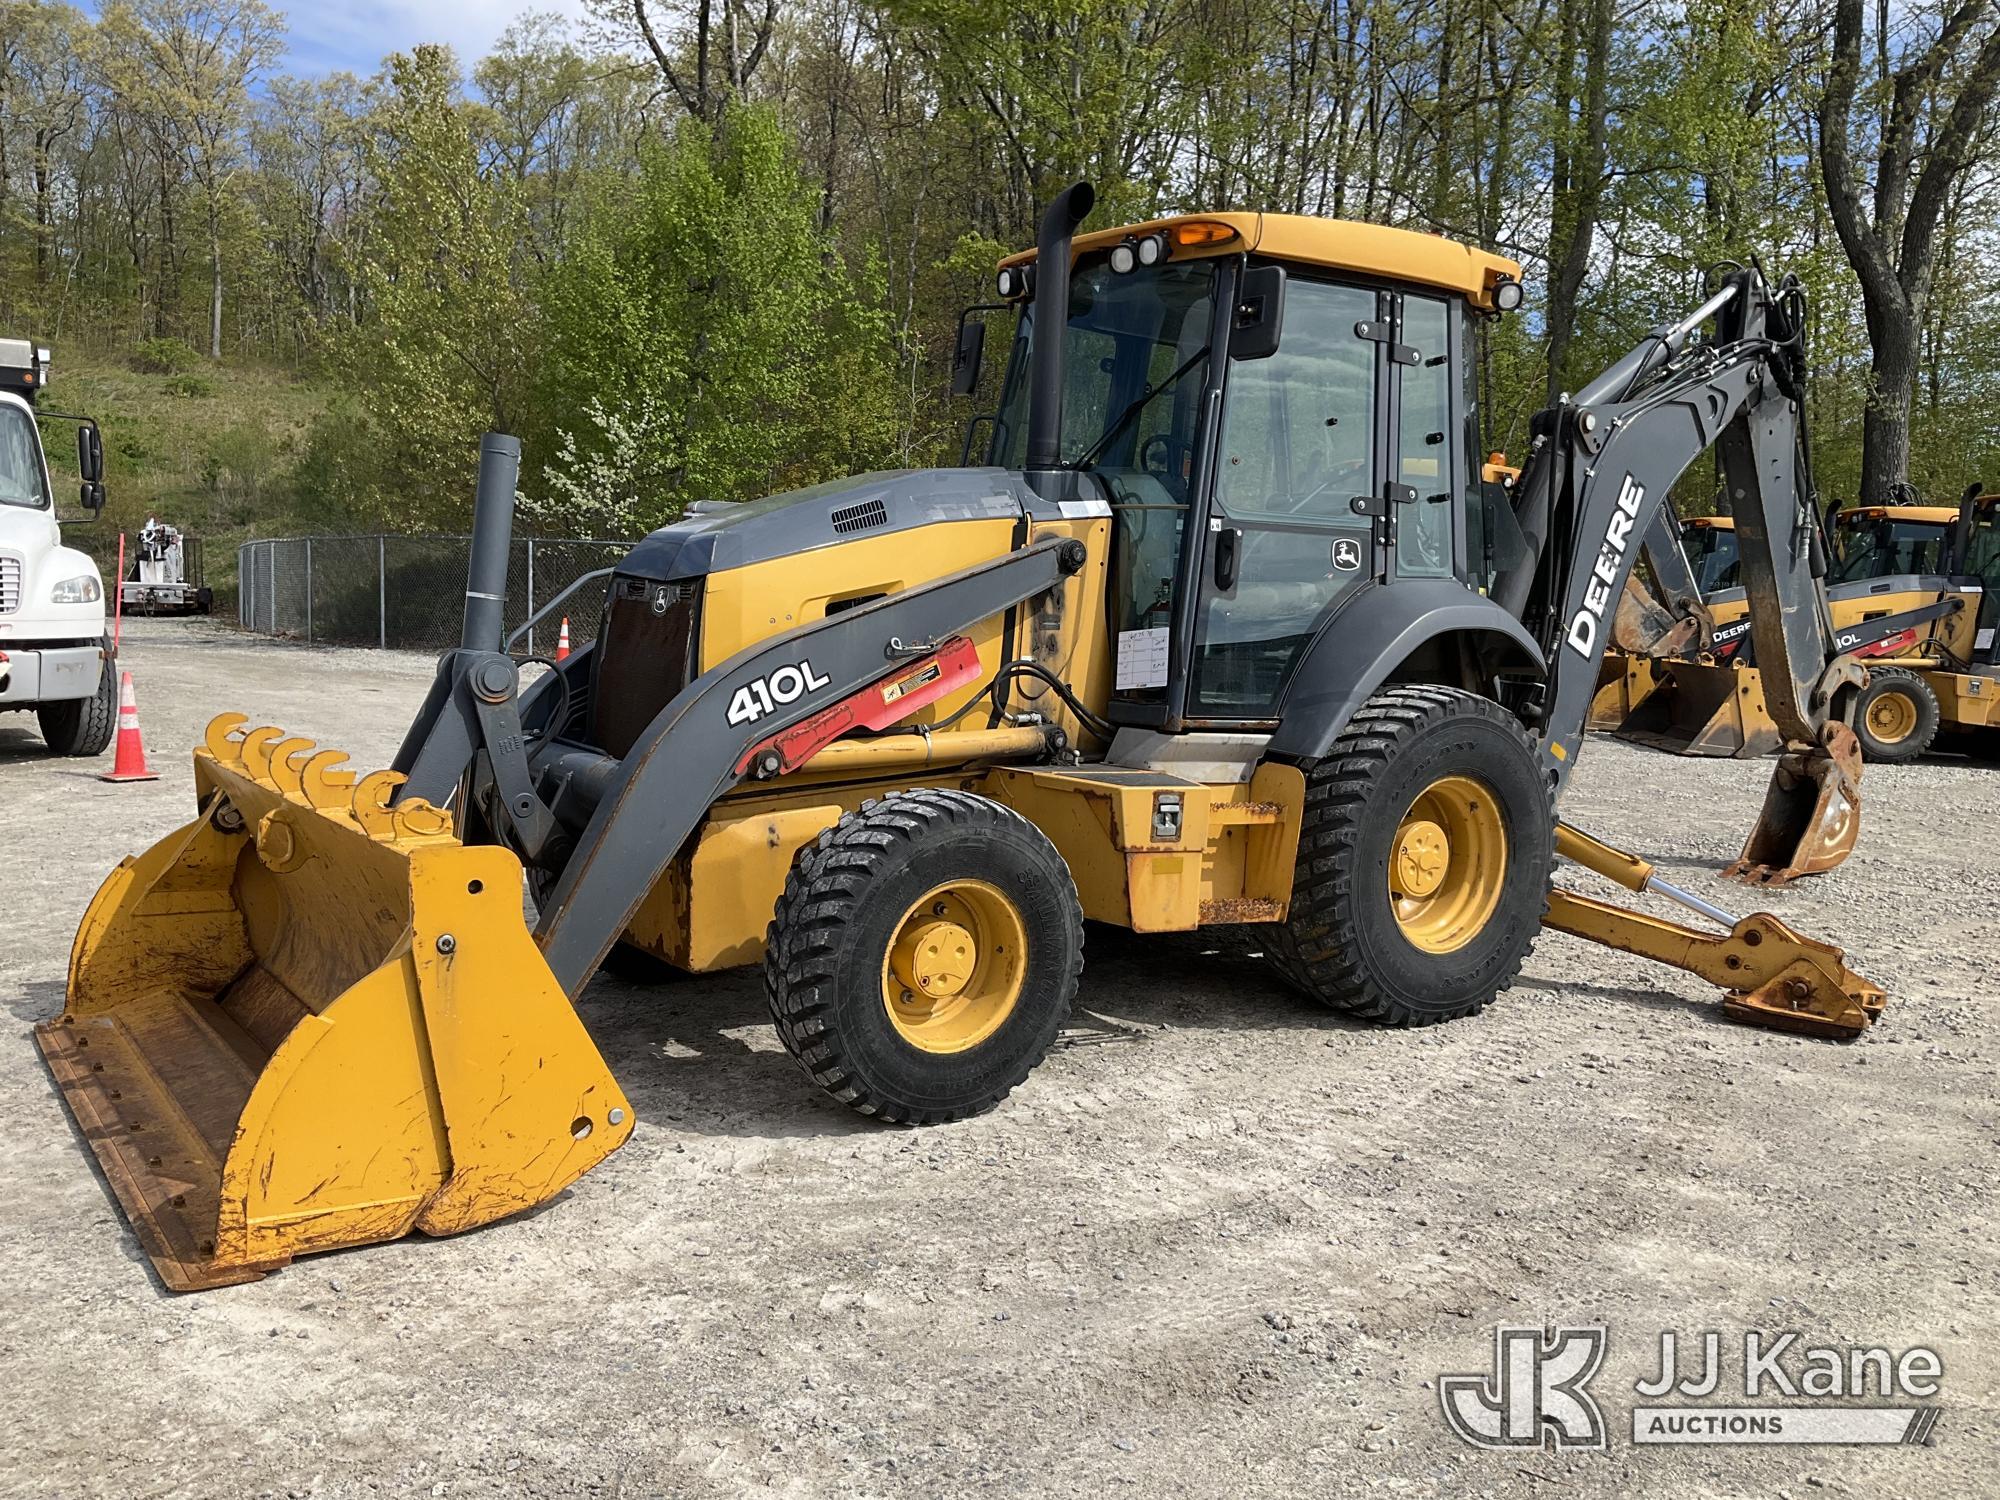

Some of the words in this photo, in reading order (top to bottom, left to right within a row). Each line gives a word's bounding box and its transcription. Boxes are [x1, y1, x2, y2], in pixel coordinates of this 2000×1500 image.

[1566, 474, 1645, 658] DEERE
[1836, 633, 1862, 649] 10L
[726, 660, 831, 727] 410L
